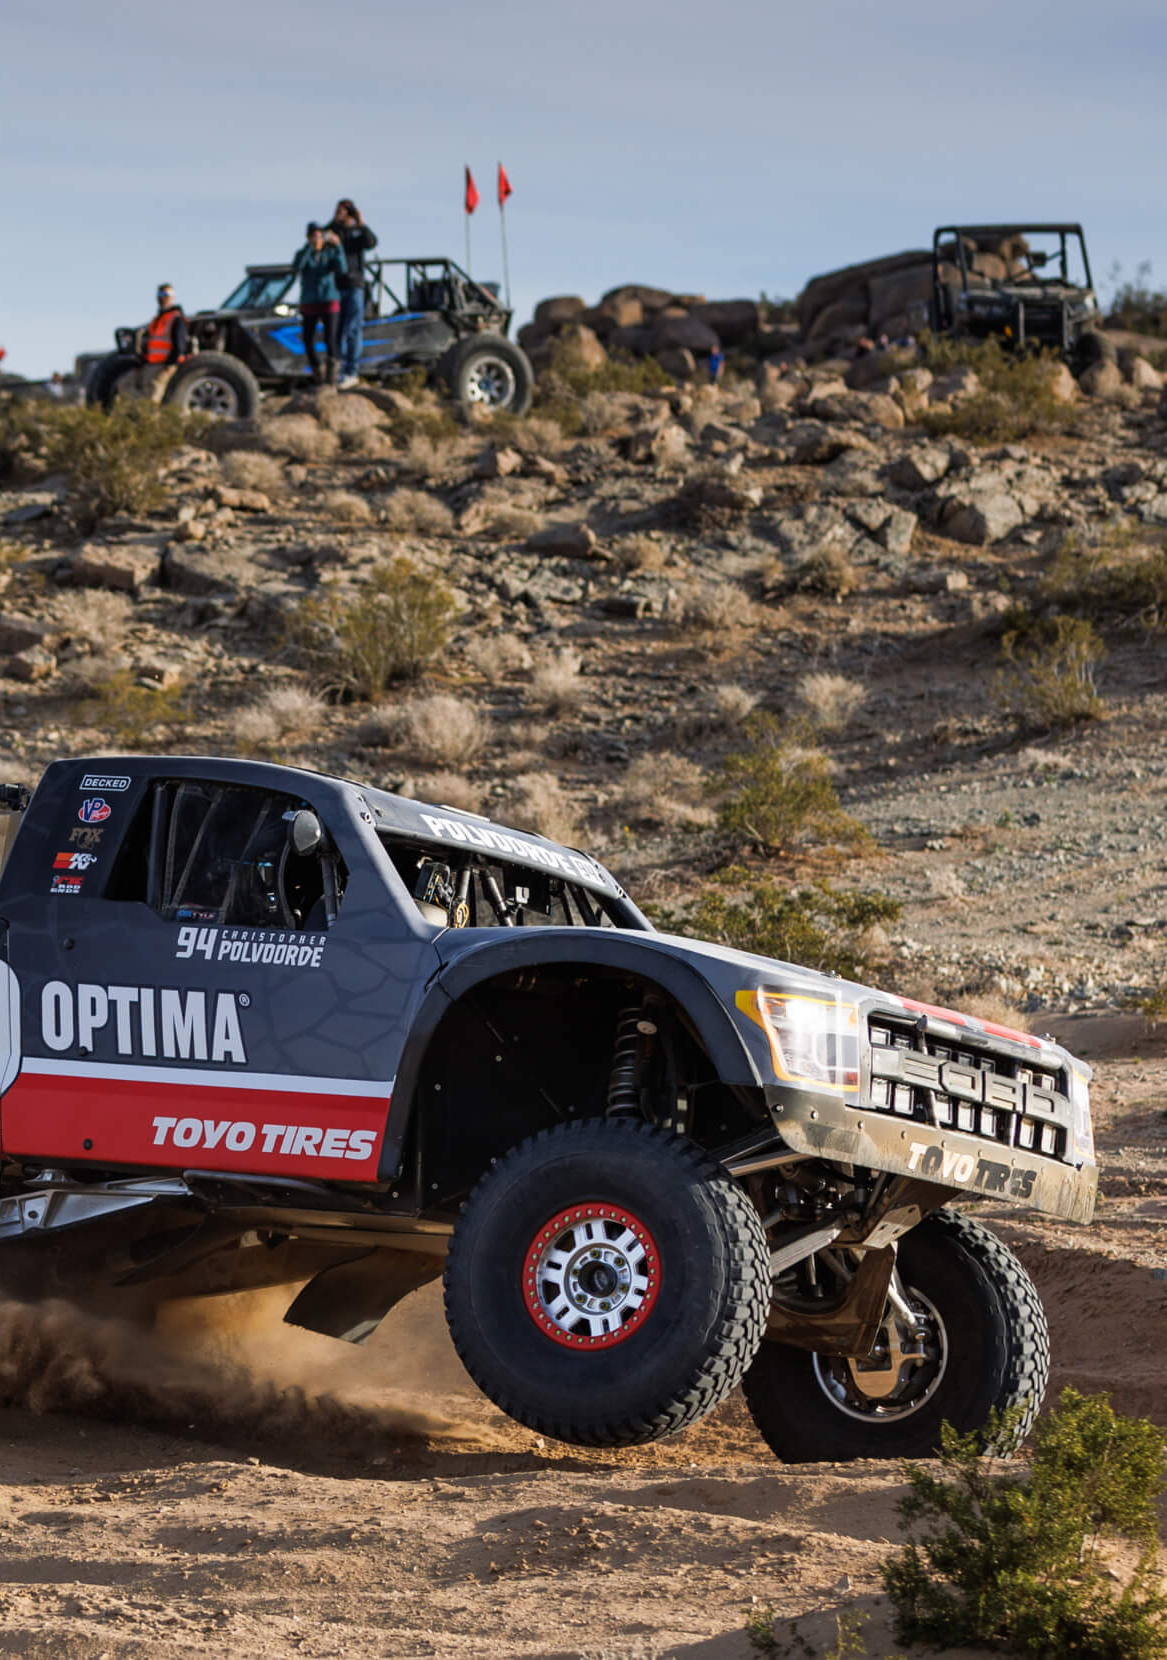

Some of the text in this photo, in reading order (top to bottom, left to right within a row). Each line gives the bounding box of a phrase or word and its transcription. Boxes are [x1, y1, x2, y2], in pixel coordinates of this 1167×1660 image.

[84, 778, 127, 789] DECKED
[82, 798, 105, 821] VP
[69, 827, 104, 842] FOX
[420, 814, 577, 877] POLVOORDE
[175, 926, 327, 960] 94 CHRISTOPHER
[217, 940, 324, 968] POLVOORDE
[152, 1116, 377, 1160] TOYO TIRES
[908, 1142, 974, 1182] TOYO
